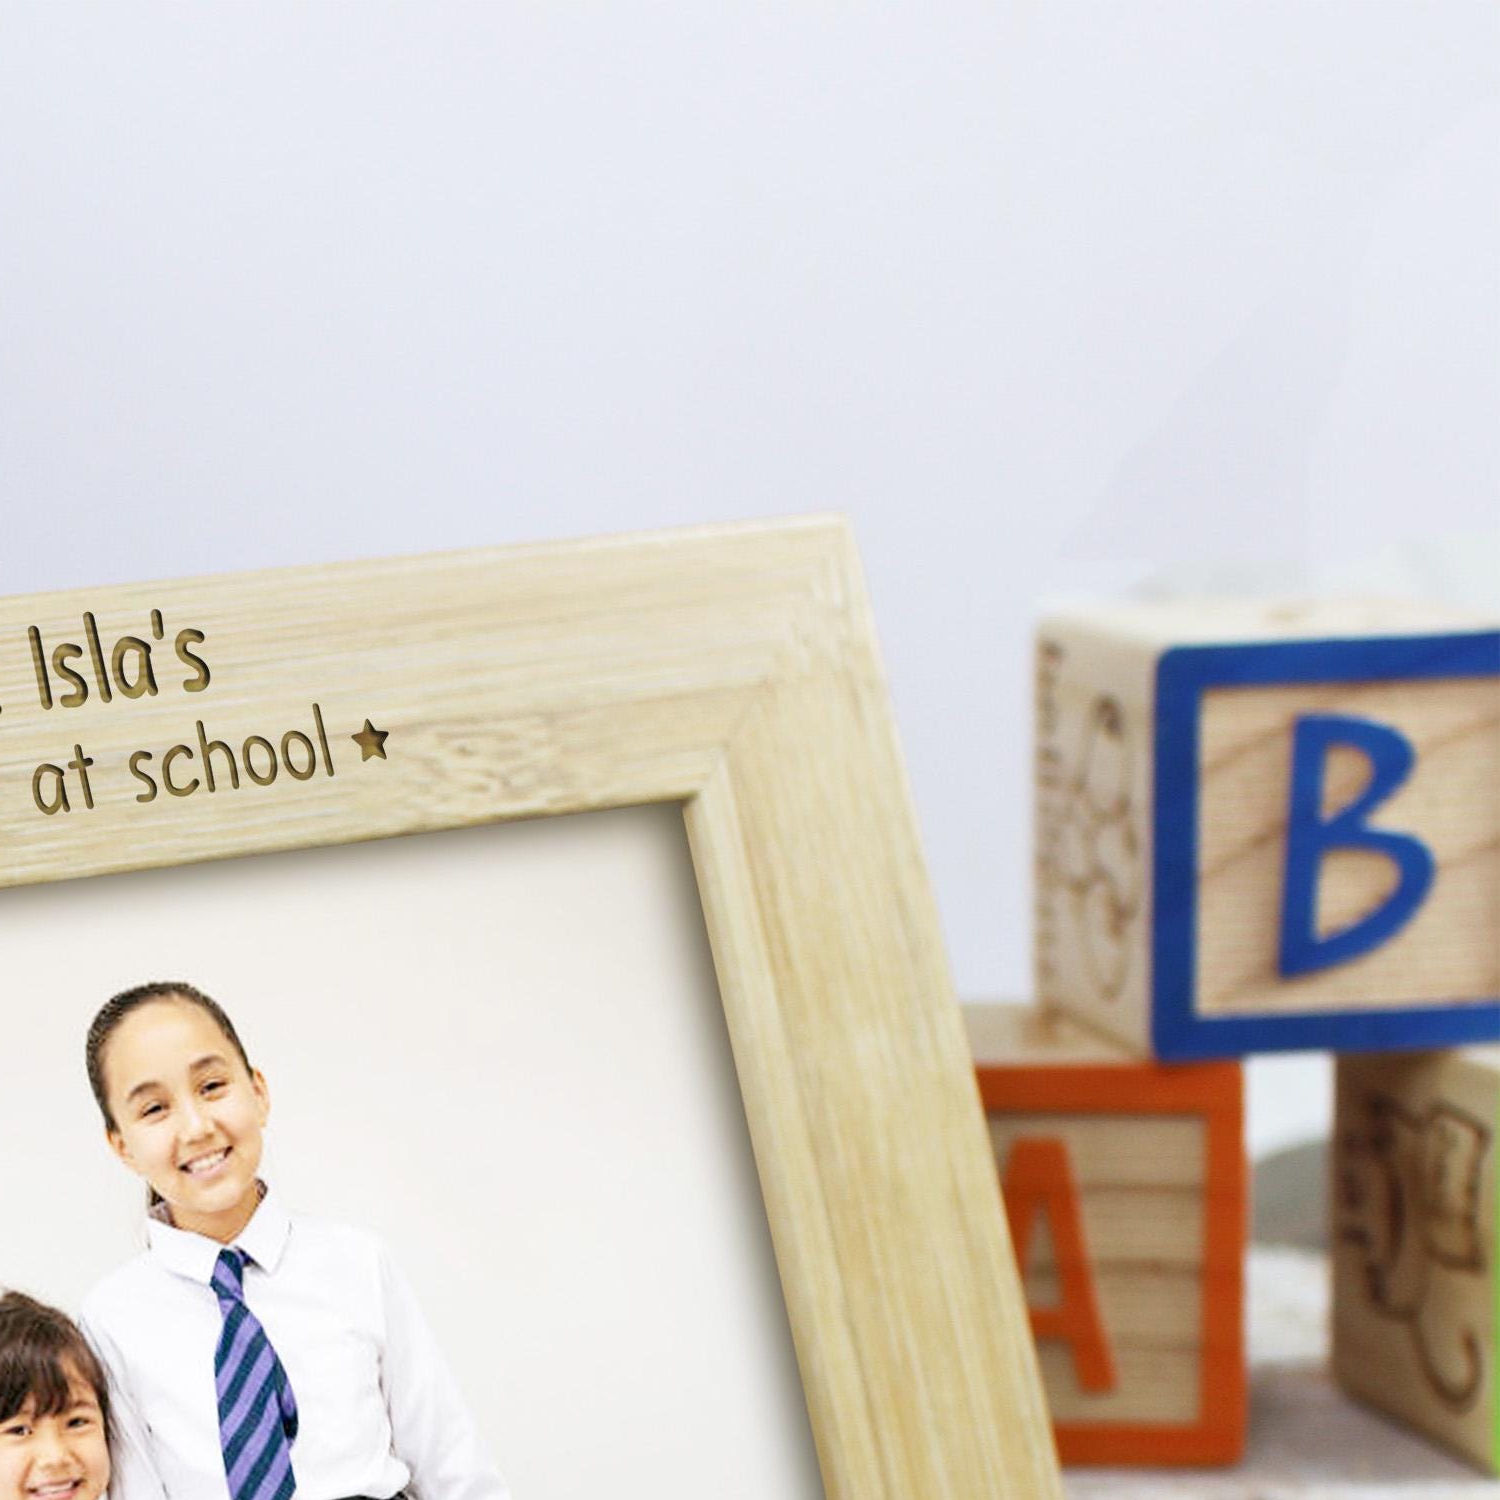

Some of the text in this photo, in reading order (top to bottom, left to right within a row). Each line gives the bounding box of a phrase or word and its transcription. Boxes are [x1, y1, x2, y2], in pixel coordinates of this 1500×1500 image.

[27, 609, 211, 710] Isla's
[32, 745, 95, 815] at
[130, 703, 335, 803] school
[1279, 713, 1436, 979] B
[1005, 1138, 1116, 1393] A
